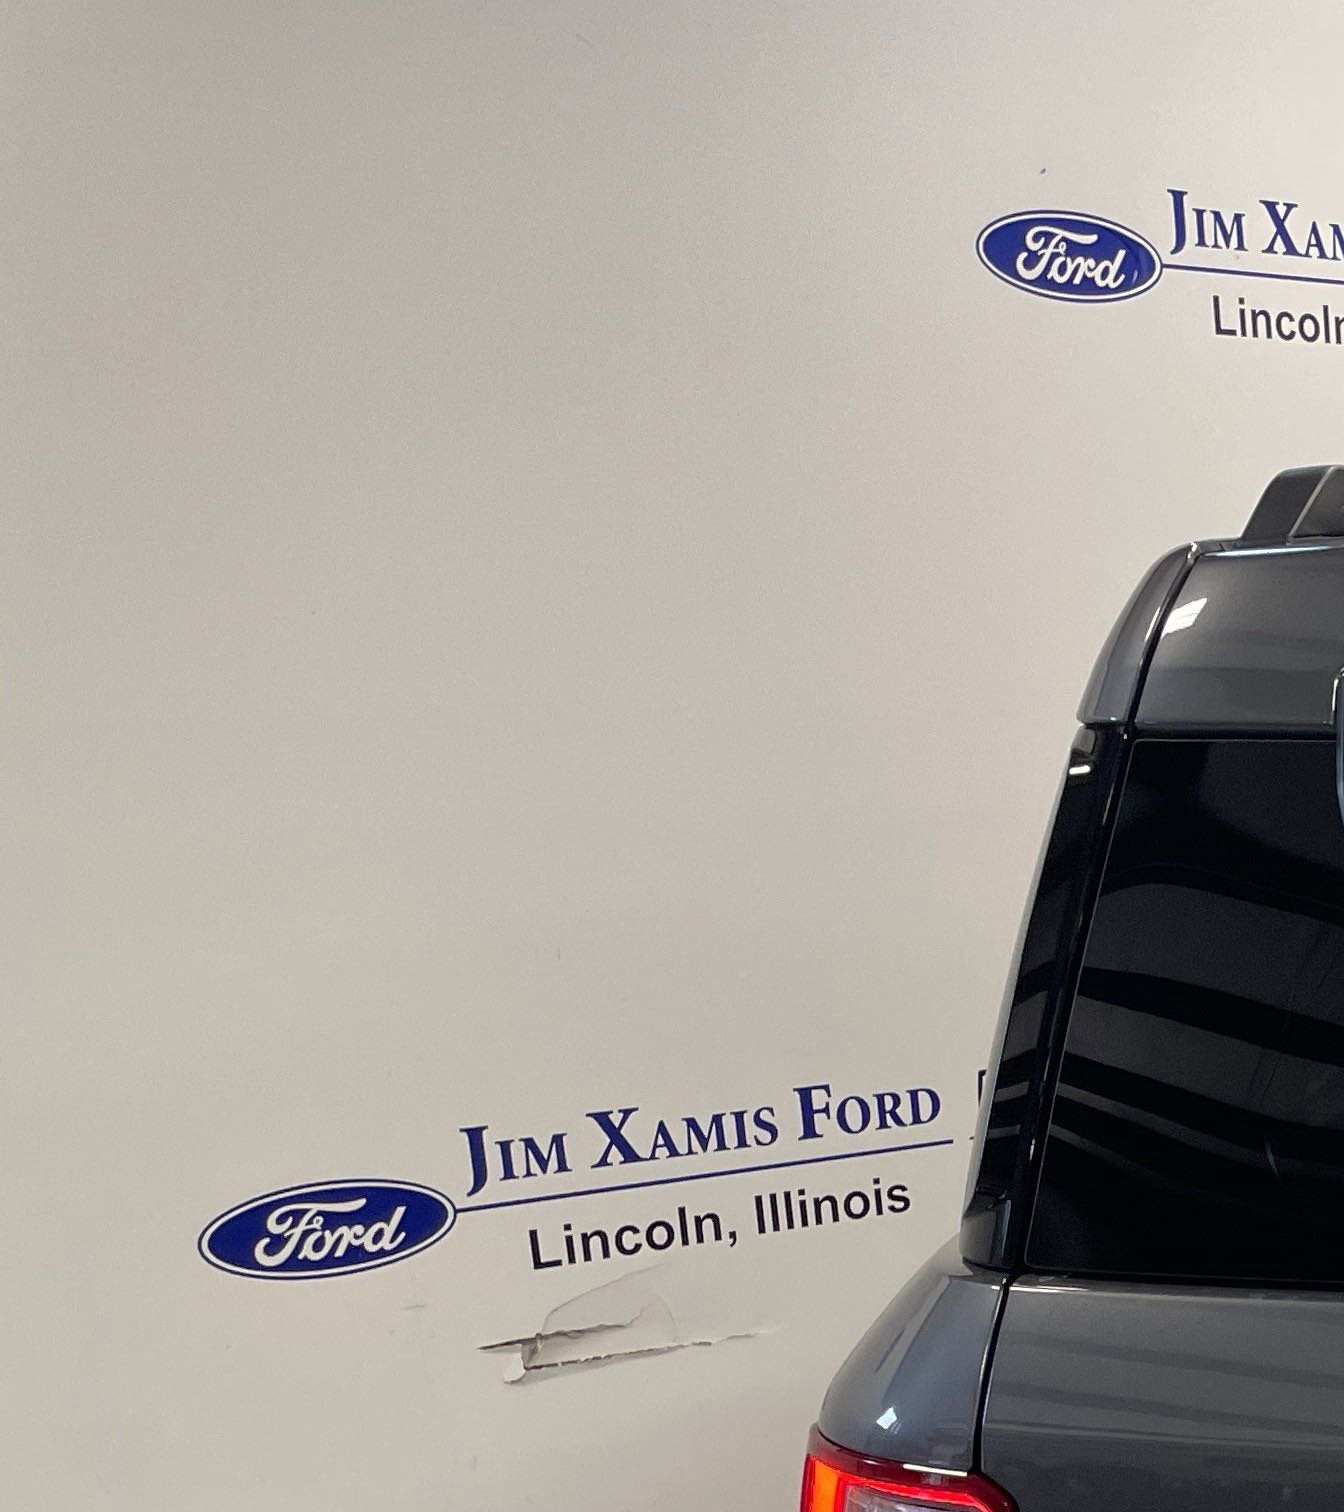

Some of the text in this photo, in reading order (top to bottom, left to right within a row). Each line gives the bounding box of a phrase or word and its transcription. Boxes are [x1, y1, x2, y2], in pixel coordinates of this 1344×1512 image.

[1167, 189, 1246, 255] JIM
[1016, 224, 1125, 290] Ford
[459, 1083, 942, 1196] JIM XAMIS FORD
[254, 1199, 406, 1267] Ford
[527, 1176, 911, 1271] Lincoln, Illinois
